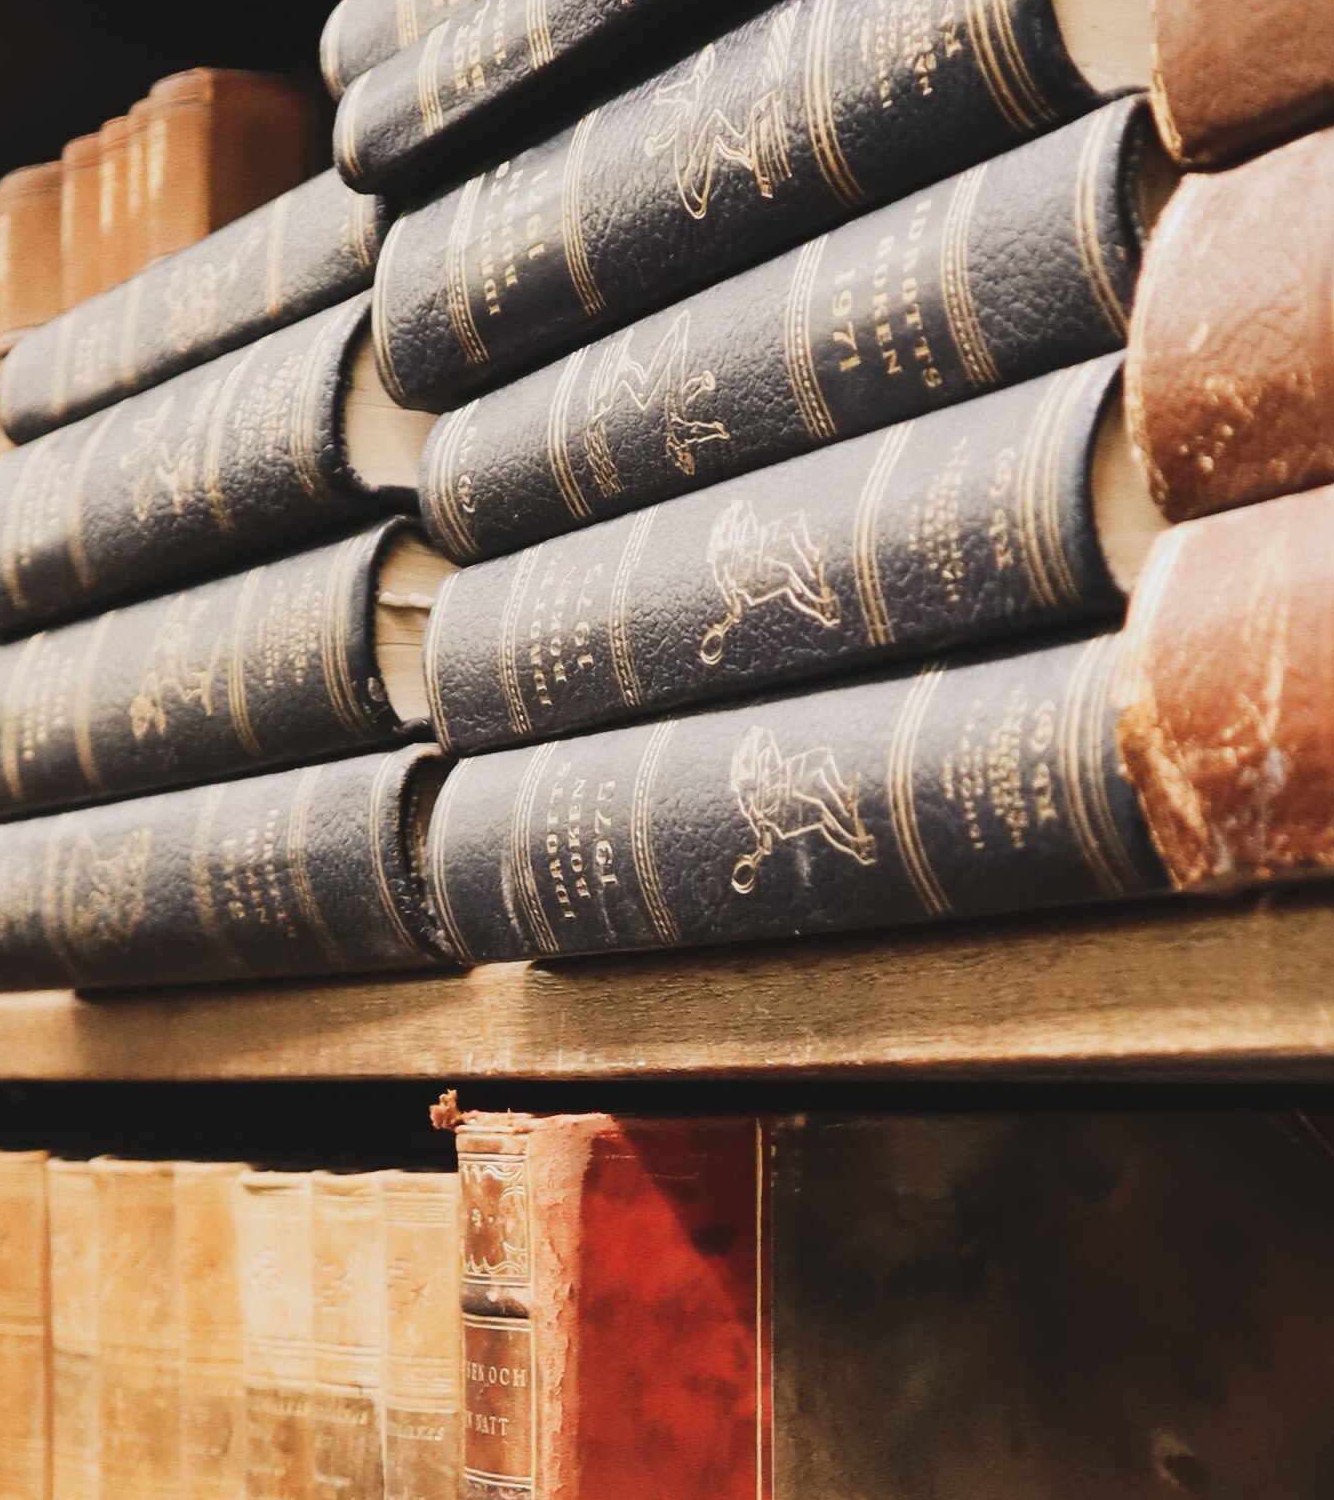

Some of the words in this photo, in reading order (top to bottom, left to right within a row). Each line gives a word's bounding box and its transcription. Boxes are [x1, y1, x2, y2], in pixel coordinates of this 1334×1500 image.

[480, 160, 511, 317] IDROTTS
[502, 169, 525, 289] BOKEN
[832, 268, 862, 374] 1971
[872, 234, 904, 376] BOKEN
[902, 199, 944, 389] IDROTTS
[530, 550, 564, 707] IDROTTS
[550, 564, 577, 684] BOKEN
[574, 562, 604, 670] 1975
[546, 761, 577, 919] IDROTTS
[567, 776, 592, 900] BOKEN
[594, 779, 618, 887] 1975
[488, 1364, 528, 1388] OCH
